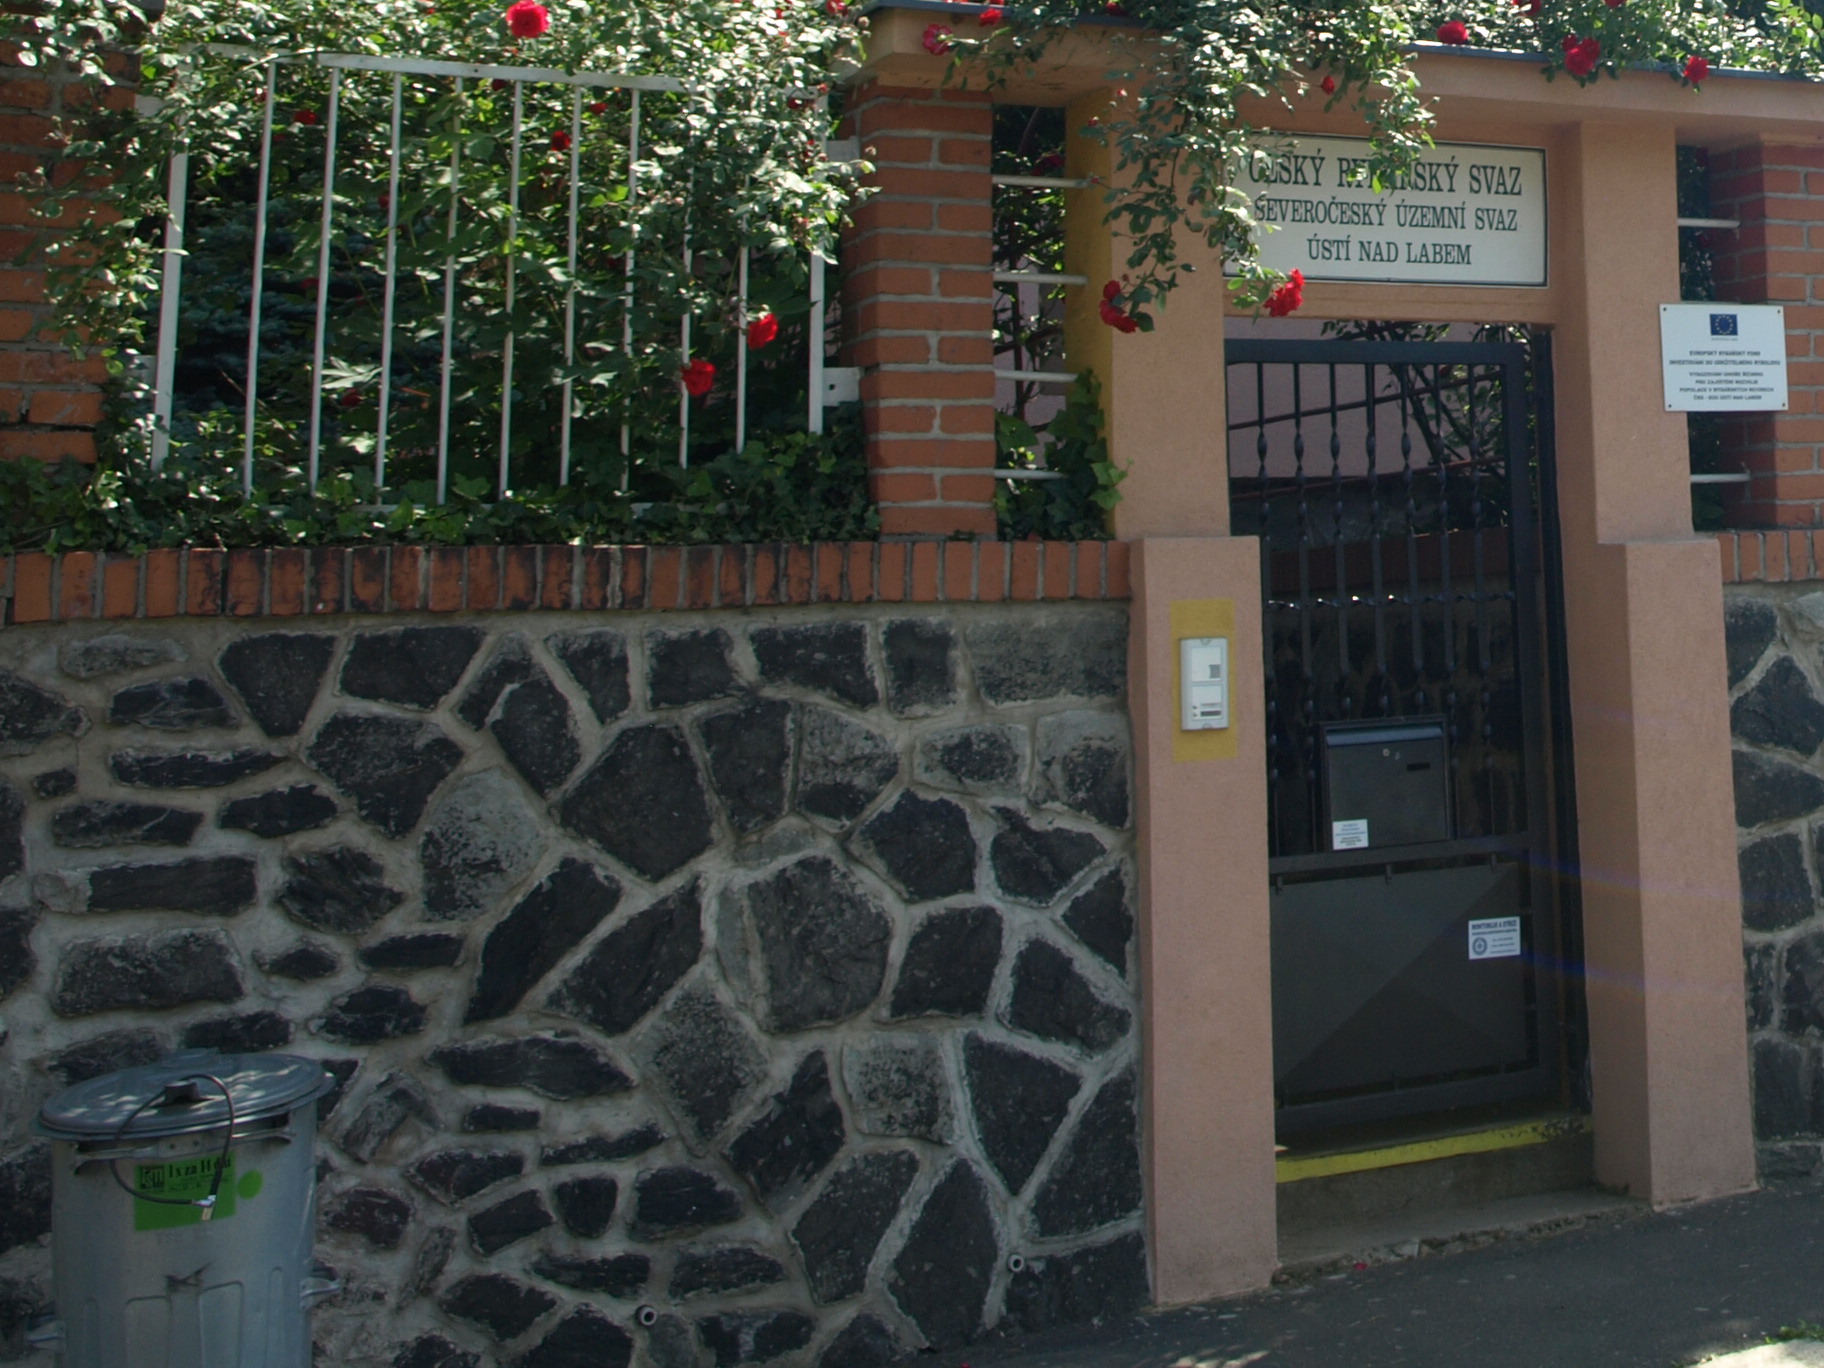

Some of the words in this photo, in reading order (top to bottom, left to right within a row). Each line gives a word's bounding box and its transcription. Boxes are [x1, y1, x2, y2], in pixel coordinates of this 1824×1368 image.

[1469, 164, 1522, 196] SVAZ
[1254, 195, 1387, 227] SEVEROČESKÝ
[1396, 198, 1466, 229] ÚZEMNÍ
[1475, 208, 1518, 232] SVAZ
[1306, 233, 1351, 261] ÚSTÍ
[1358, 240, 1399, 263] NAD
[1405, 242, 1472, 266] LABEM
